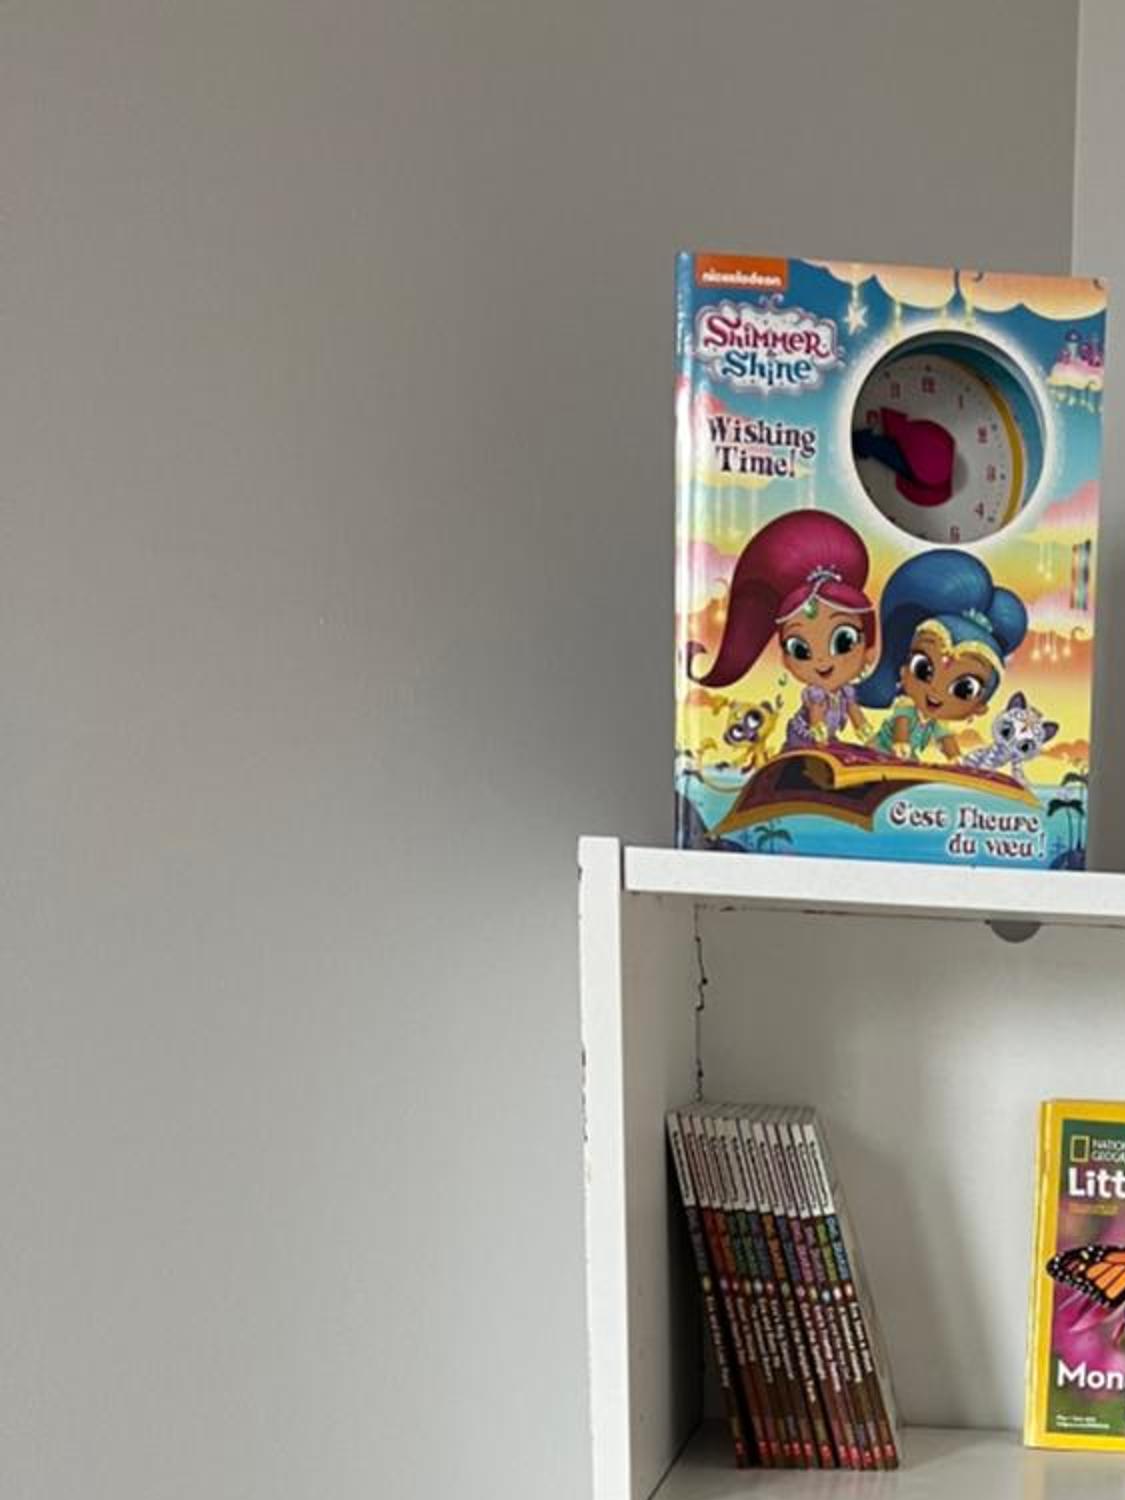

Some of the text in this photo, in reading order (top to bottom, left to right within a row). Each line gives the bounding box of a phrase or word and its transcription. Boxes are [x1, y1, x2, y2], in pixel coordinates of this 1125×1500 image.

[721, 350, 812, 385] Shine
[707, 415, 816, 459] Wishing
[714, 445, 796, 477] Time!
[948, 833, 976, 855] du
